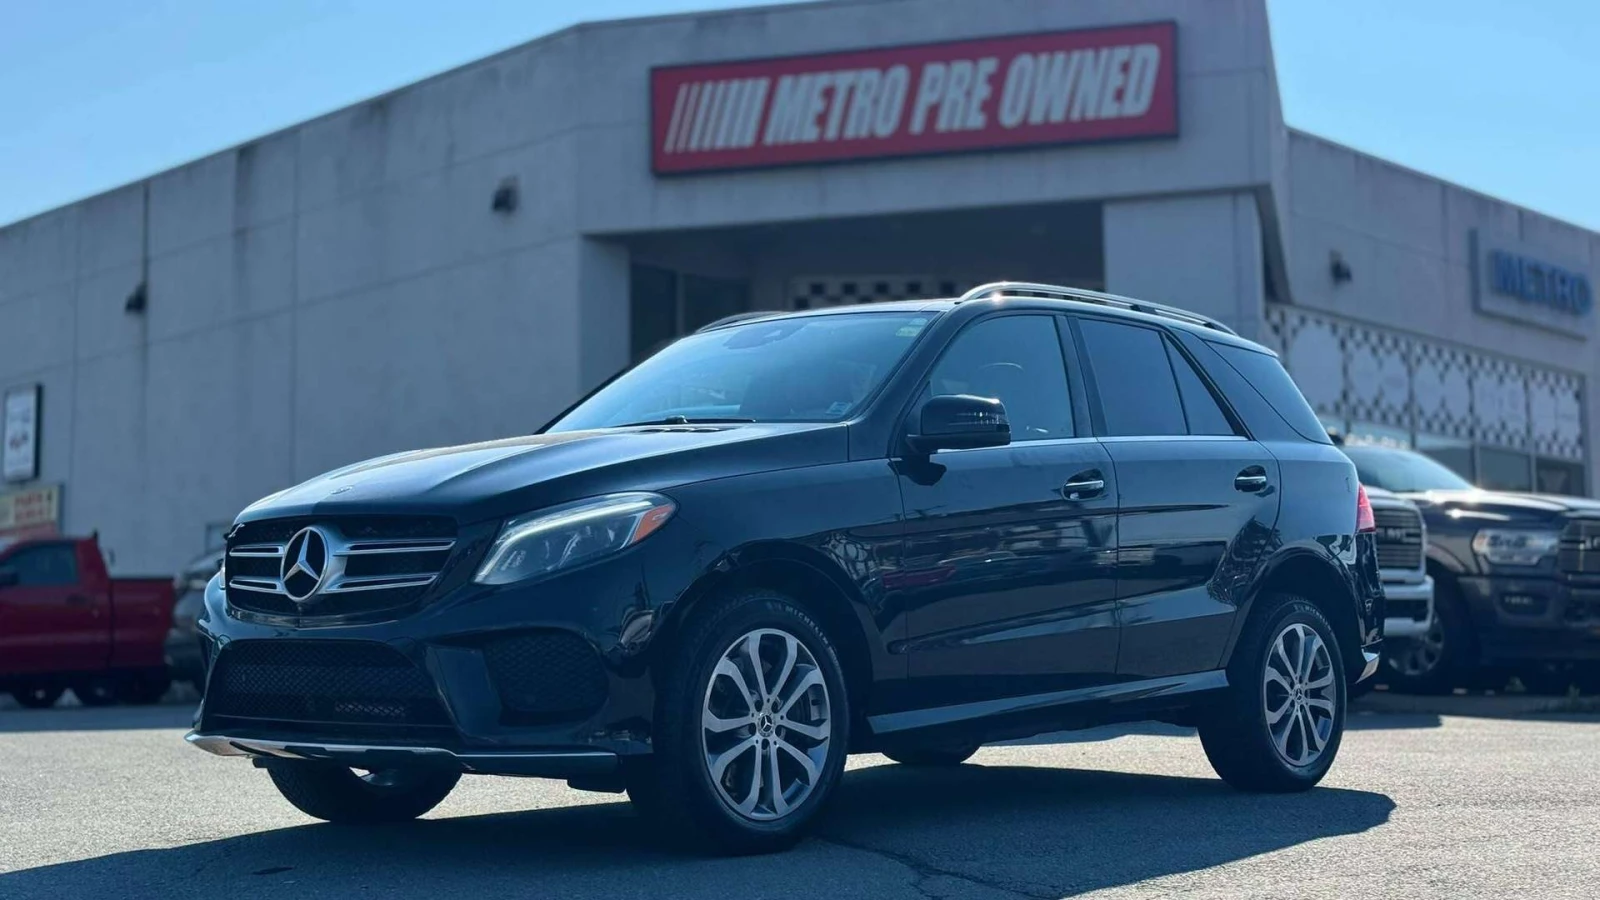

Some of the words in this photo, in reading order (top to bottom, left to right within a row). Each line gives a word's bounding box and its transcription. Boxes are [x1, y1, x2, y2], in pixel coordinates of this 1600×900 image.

[763, 65, 910, 146] METRO
[909, 58, 998, 135] PRE
[998, 44, 1161, 128] OWNED
[1489, 249, 1592, 316] METRO
